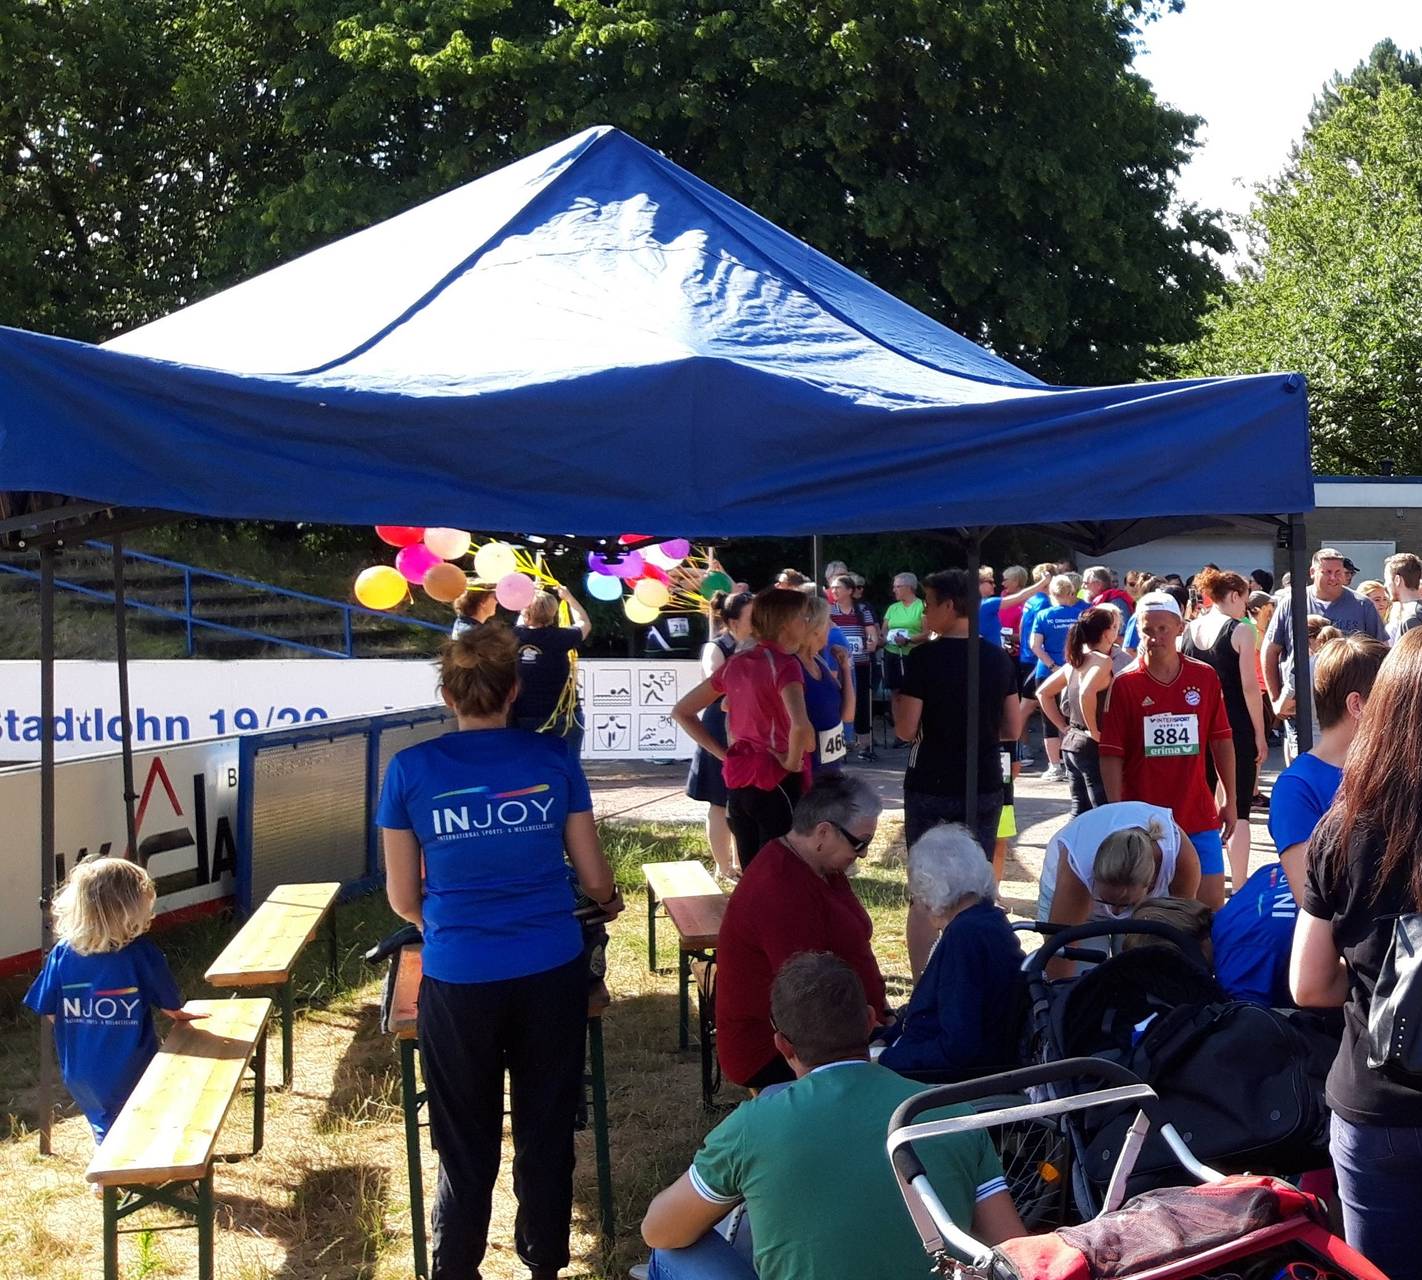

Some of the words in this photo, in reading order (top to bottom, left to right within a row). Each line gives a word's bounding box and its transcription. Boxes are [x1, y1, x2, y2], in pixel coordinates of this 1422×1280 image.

[1153, 727, 1190, 745] 884
[1150, 746, 1181, 755] erima
[432, 797, 555, 834] INJOY
[63, 998, 140, 1019] NJOY
